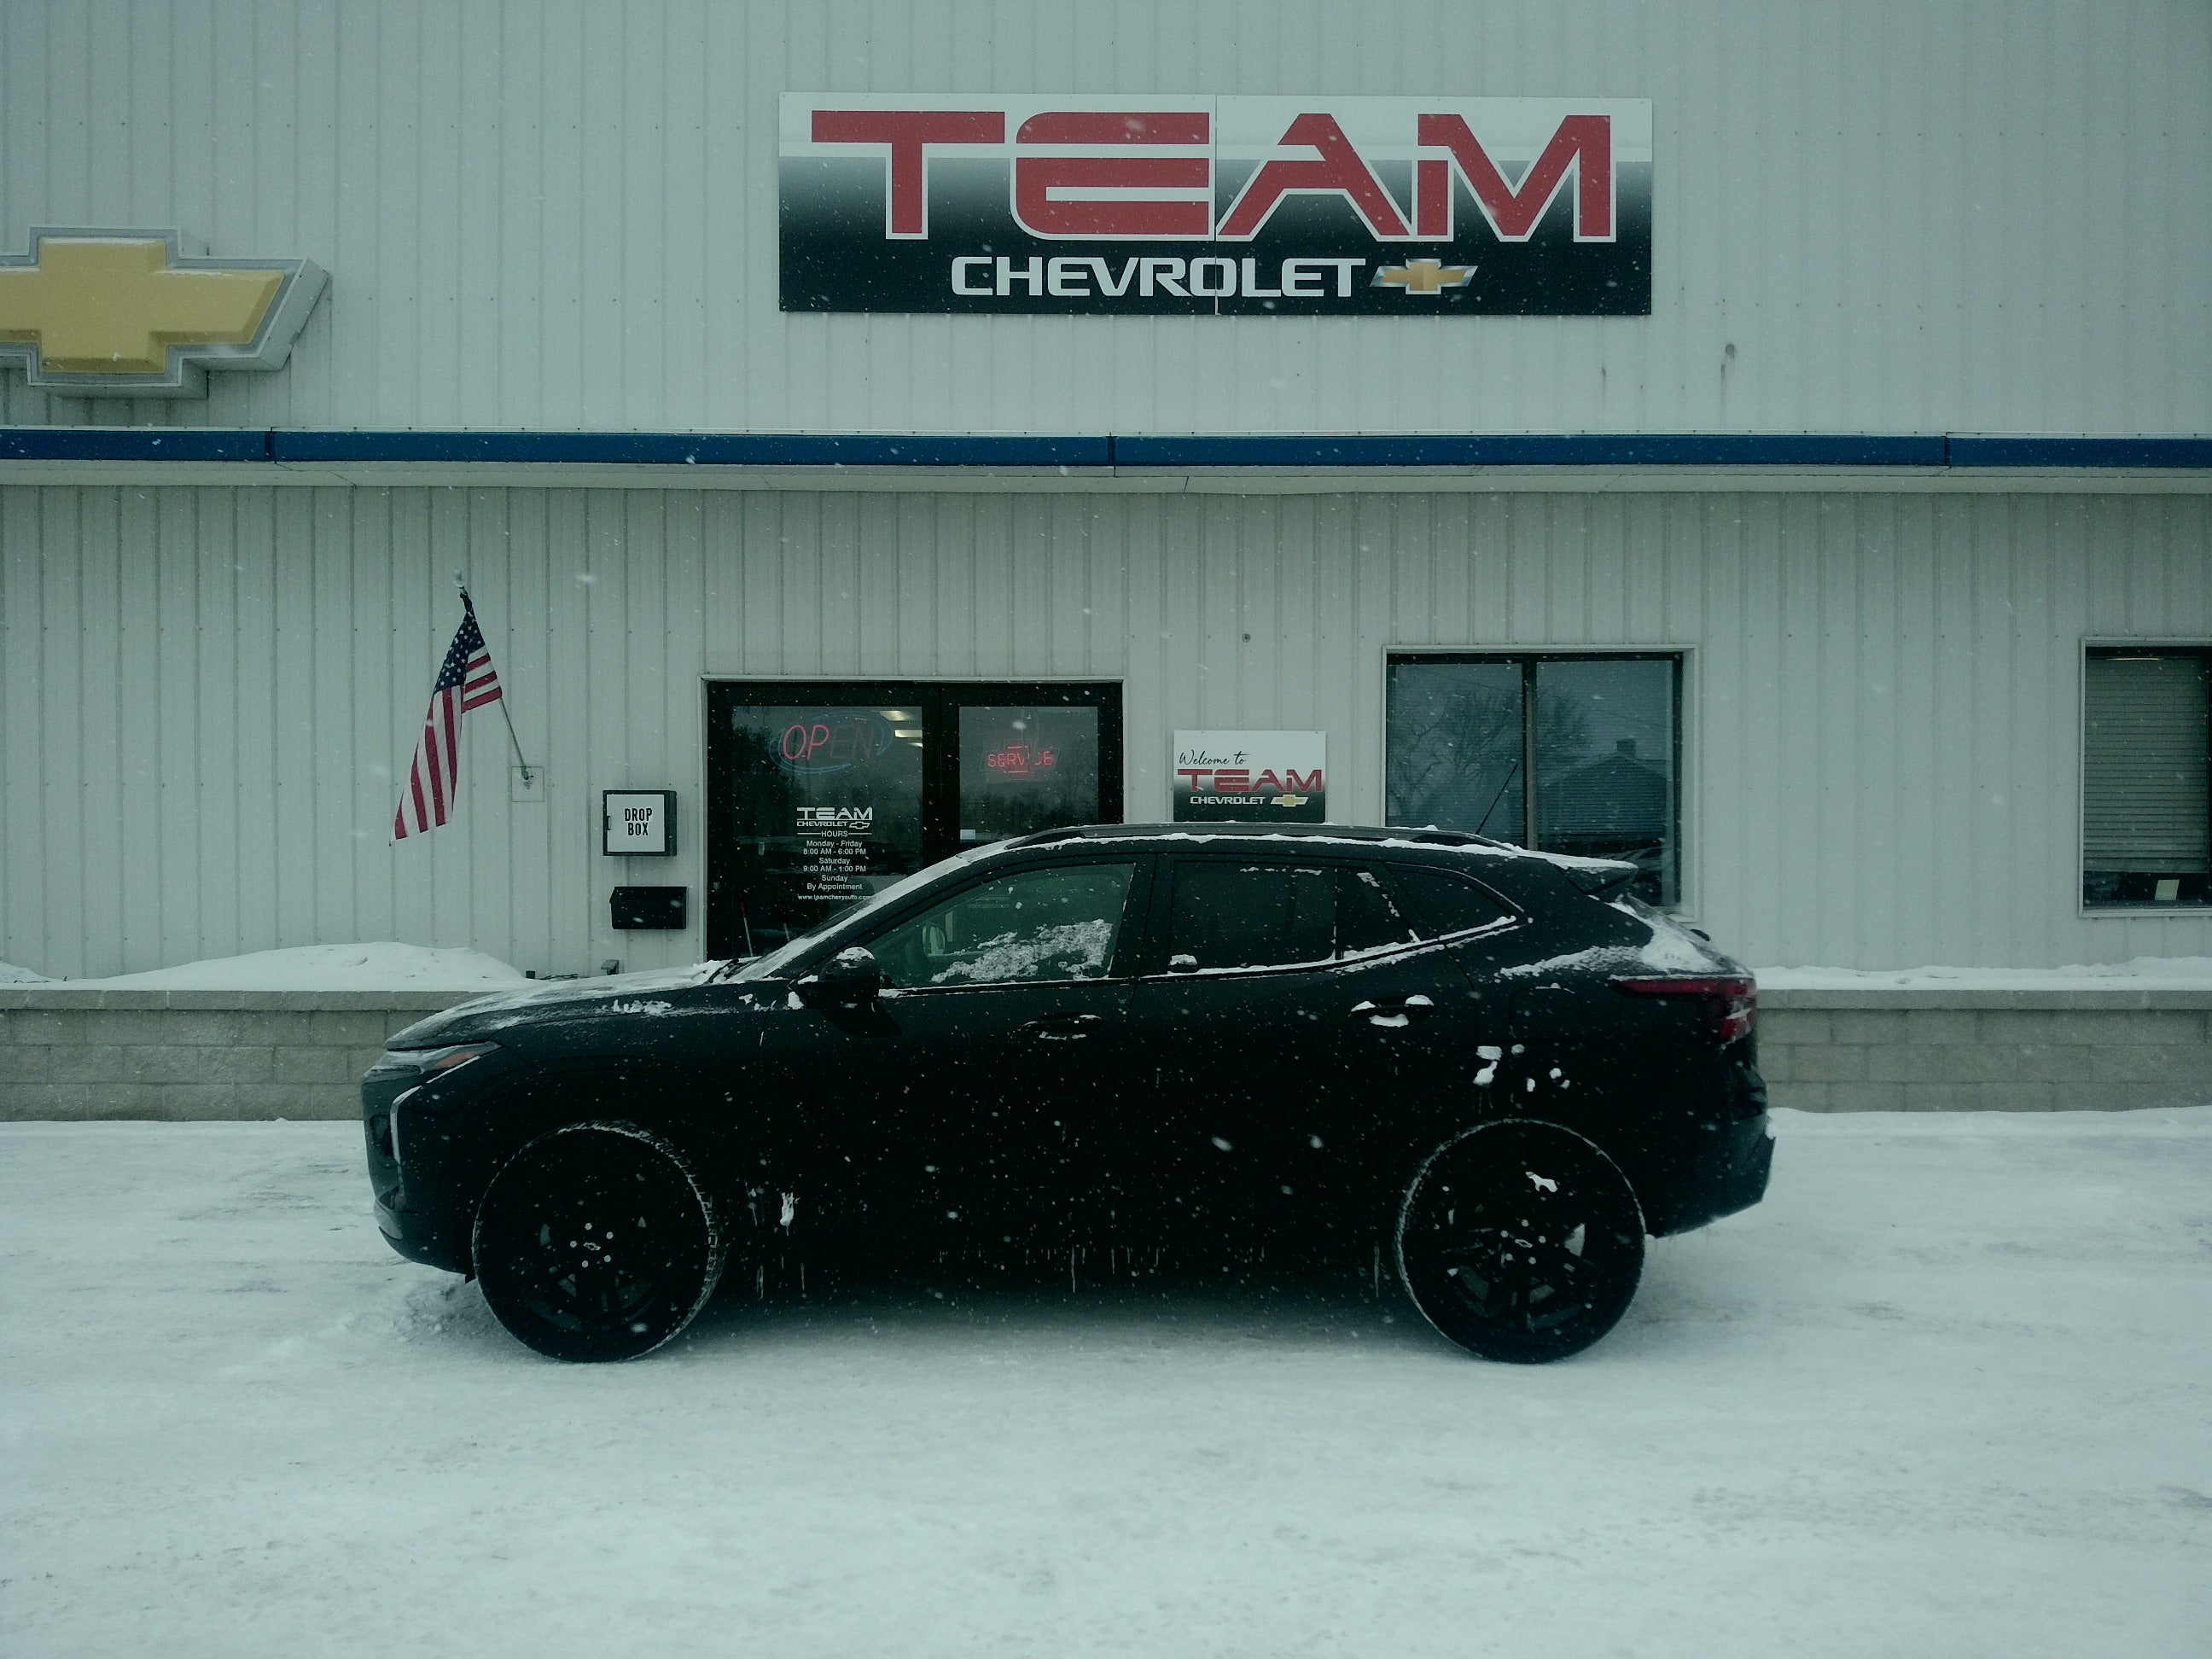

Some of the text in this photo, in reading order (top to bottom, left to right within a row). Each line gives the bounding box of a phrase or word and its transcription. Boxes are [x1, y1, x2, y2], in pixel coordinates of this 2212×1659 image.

[811, 109, 1617, 242] TEAM
[950, 256, 1365, 300] CHEVROLET
[783, 725, 874, 760] OPEN
[987, 751, 1053, 767] SERVCE
[1179, 749, 1251, 765] Welcome to
[1177, 768, 1322, 793] TEAM
[1190, 796, 1266, 805] CHEVROLET
[625, 808, 652, 822] DROP
[796, 806, 873, 821] TEAM
[627, 822, 649, 836] BOX
[806, 840, 835, 848] Monday
[841, 840, 863, 848] Friday
[818, 857, 851, 865] Saturday
[821, 874, 848, 882] Sunday
[806, 882, 863, 892] By Appointment
